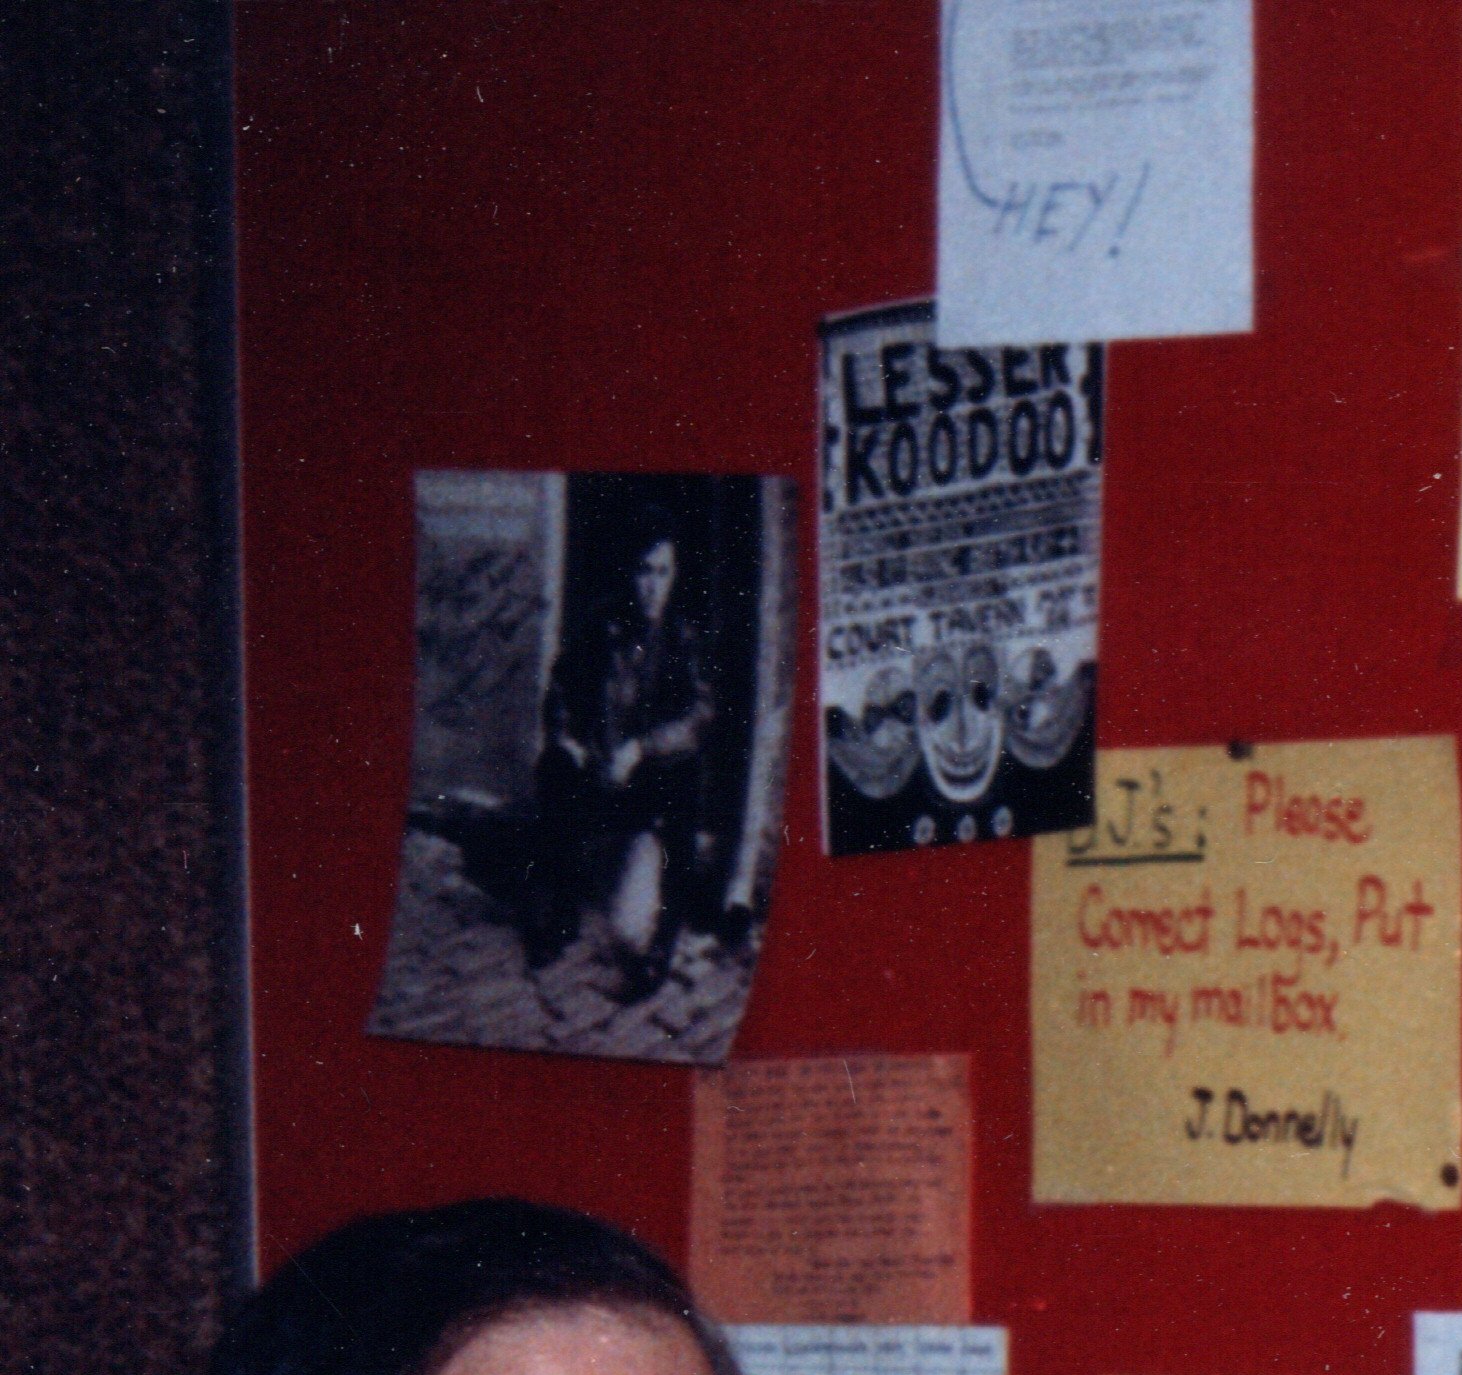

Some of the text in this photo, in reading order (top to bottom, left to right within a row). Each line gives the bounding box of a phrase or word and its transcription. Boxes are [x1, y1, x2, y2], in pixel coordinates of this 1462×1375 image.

[994, 160, 1151, 258] HEY!
[842, 342, 1071, 425] LESSER
[847, 391, 1075, 504] KOODOO
[1243, 770, 1372, 845] Please
[1077, 883, 1216, 956] Correct
[1353, 873, 1435, 952] Put
[1076, 971, 1112, 1029] in
[1128, 986, 1181, 1058] my
[1224, 1088, 1358, 1180] Donnelly
